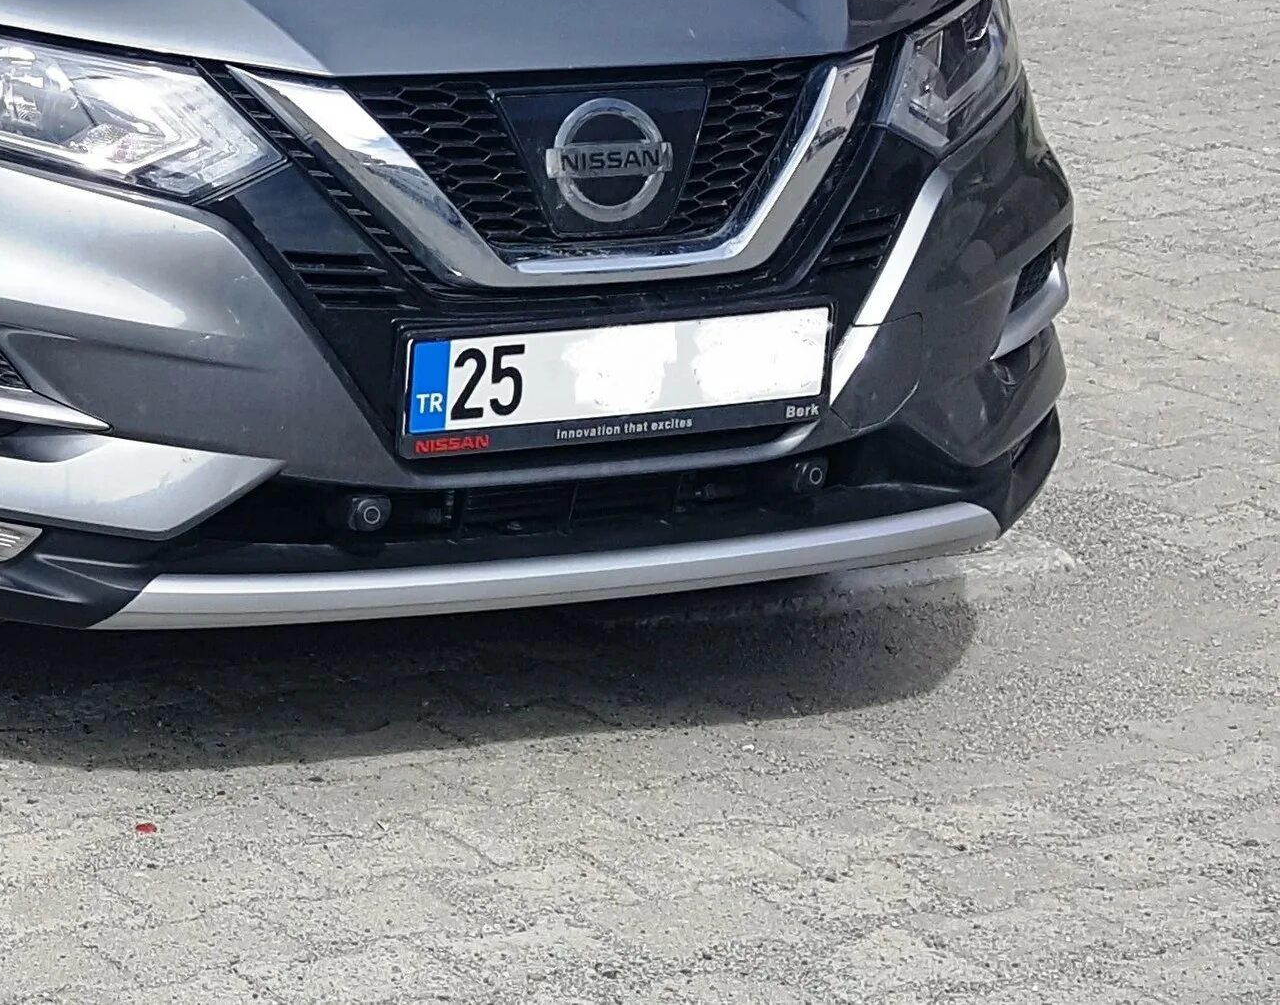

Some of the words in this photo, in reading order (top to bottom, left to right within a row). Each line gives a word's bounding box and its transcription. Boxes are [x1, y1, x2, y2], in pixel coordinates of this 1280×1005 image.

[561, 150, 659, 171] NISSAN
[416, 393, 443, 414] TR
[451, 344, 526, 420] 25
[556, 425, 621, 440] Innovation
[624, 421, 648, 434] that
[651, 418, 693, 431] excites
[416, 435, 489, 453] NISSAN
